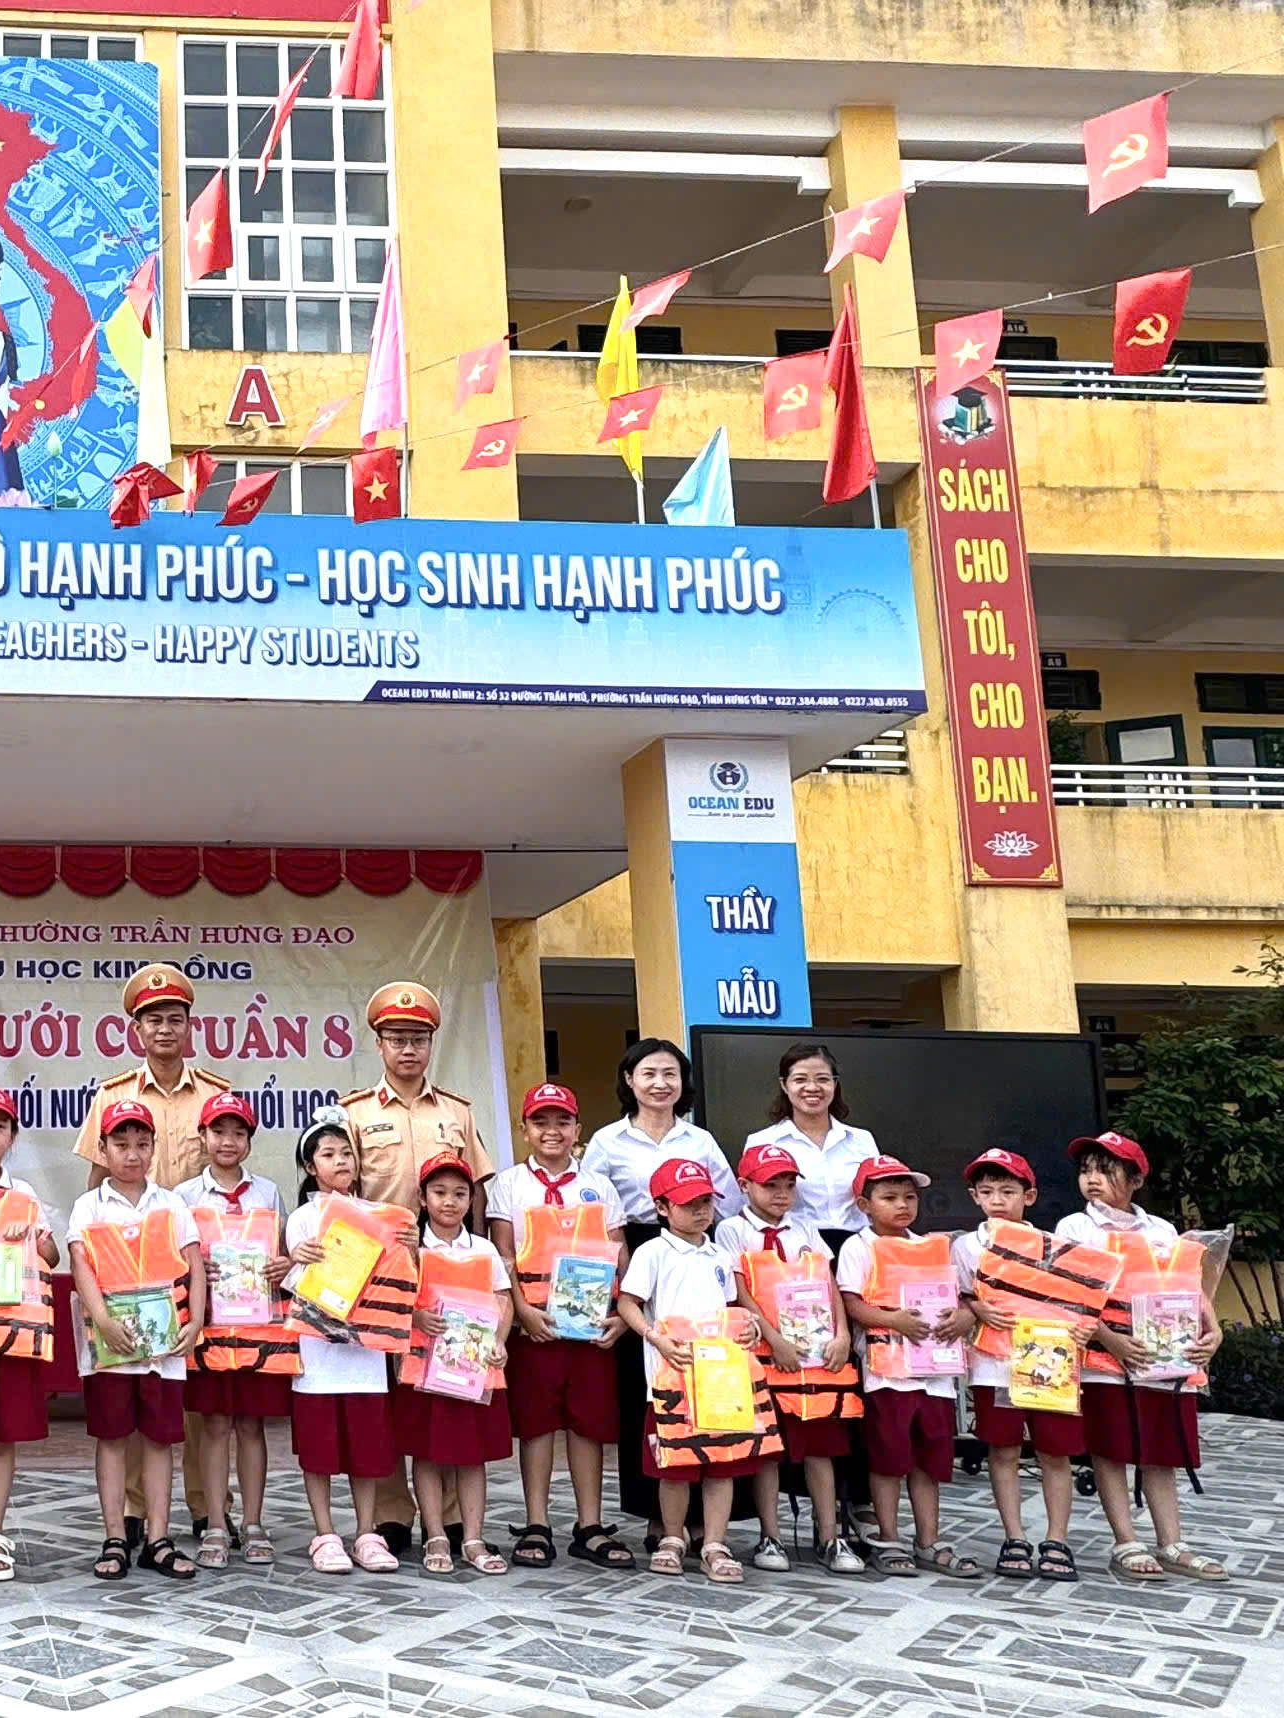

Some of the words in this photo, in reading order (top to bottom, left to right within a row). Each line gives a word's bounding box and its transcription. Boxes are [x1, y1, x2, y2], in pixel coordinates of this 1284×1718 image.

[226, 365, 285, 426] A
[938, 459, 1010, 512] SÁCH
[20, 540, 146, 610] HẠNH
[156, 534, 277, 602] PHÚC
[317, 548, 409, 620] HỌC
[417, 551, 525, 611] SINH
[532, 554, 657, 622] HẠNH
[666, 547, 786, 614] PHÚC
[954, 538, 1009, 583] CHO
[154, 624, 256, 664] HAPPY
[262, 627, 419, 668] STUDENTS
[963, 601, 1014, 660] TÔI,
[381, 688, 410, 698] OCEAN
[411, 688, 429, 698] EDU
[452, 688, 475, 700] BÌNH
[970, 682, 1024, 728] CHO
[688, 797, 739, 809] OCEAN
[743, 798, 774, 810] EDU
[972, 757, 1038, 813] BẠN.
[705, 886, 774, 930] THẦY
[111, 917, 191, 943] TRẦN
[200, 924, 283, 945] HƯNG
[292, 926, 355, 948] ĐẠO
[17, 960, 82, 984] HỌC
[718, 967, 777, 1015] MẪU
[323, 1014, 353, 1058] 8
